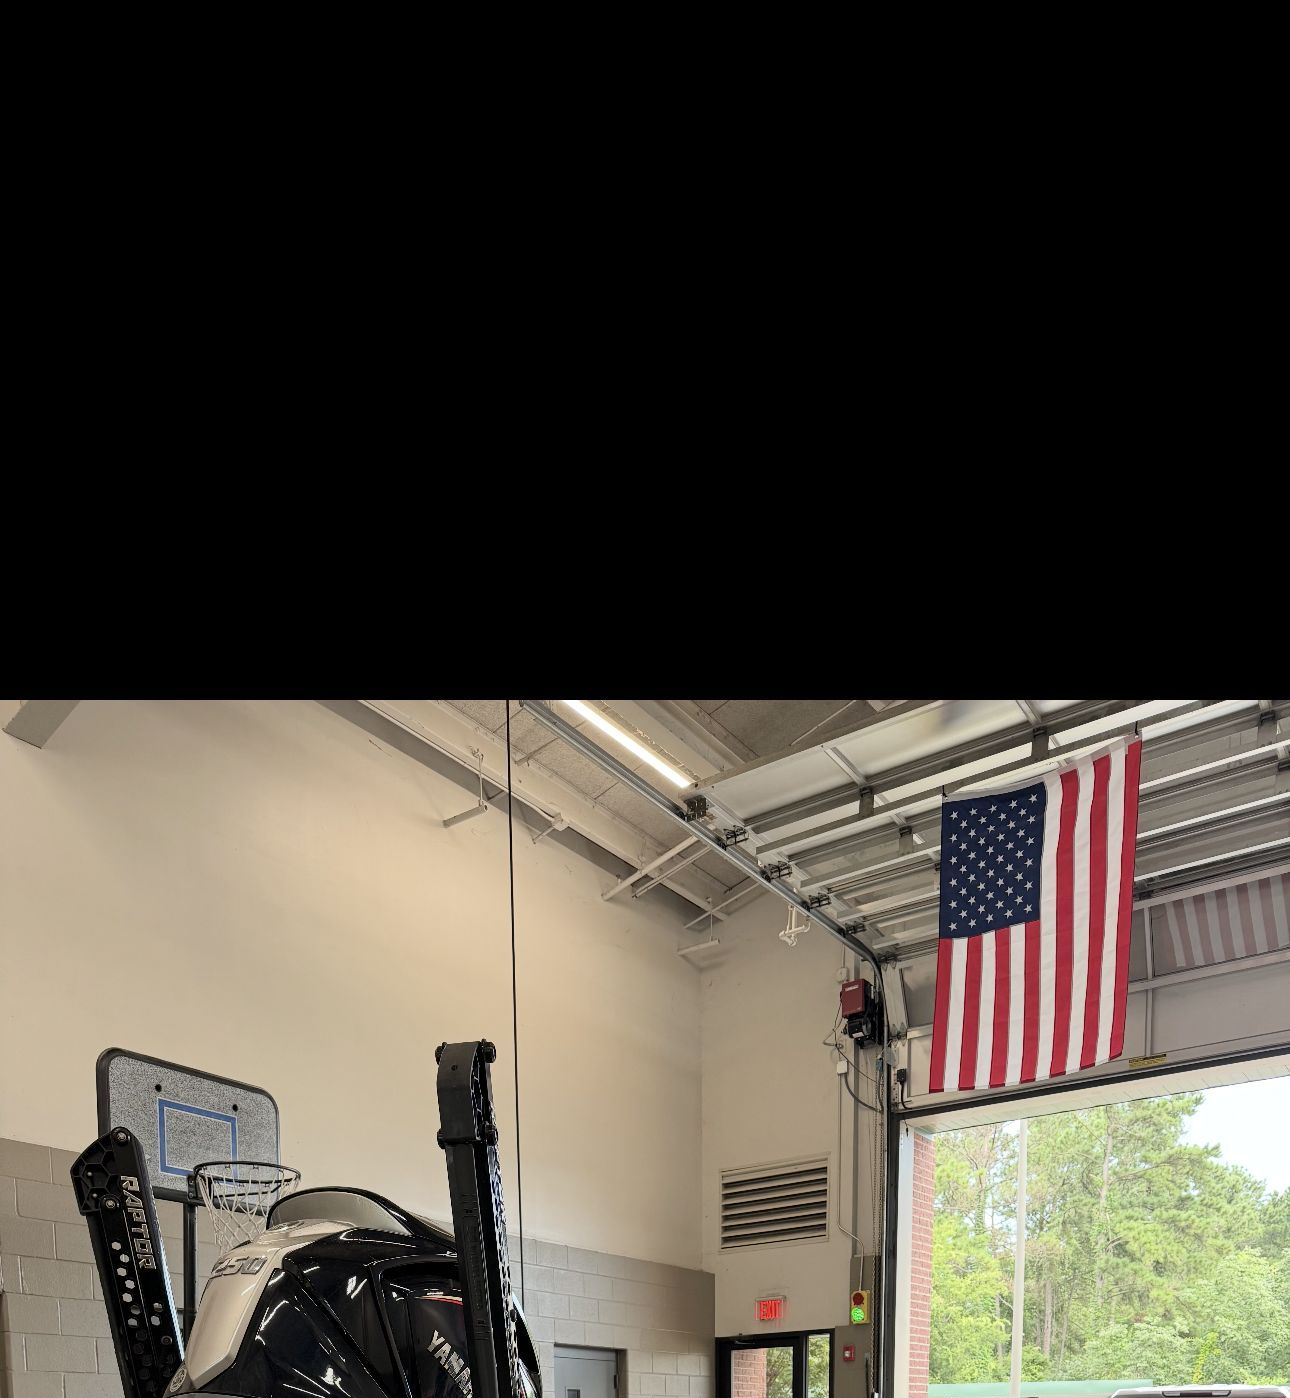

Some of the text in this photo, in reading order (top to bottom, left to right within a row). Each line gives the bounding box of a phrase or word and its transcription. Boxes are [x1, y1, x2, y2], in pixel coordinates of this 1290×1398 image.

[121, 1175, 156, 1270] RAPTOR
[211, 1256, 267, 1279] 250
[760, 1299, 780, 1320] EXIT
